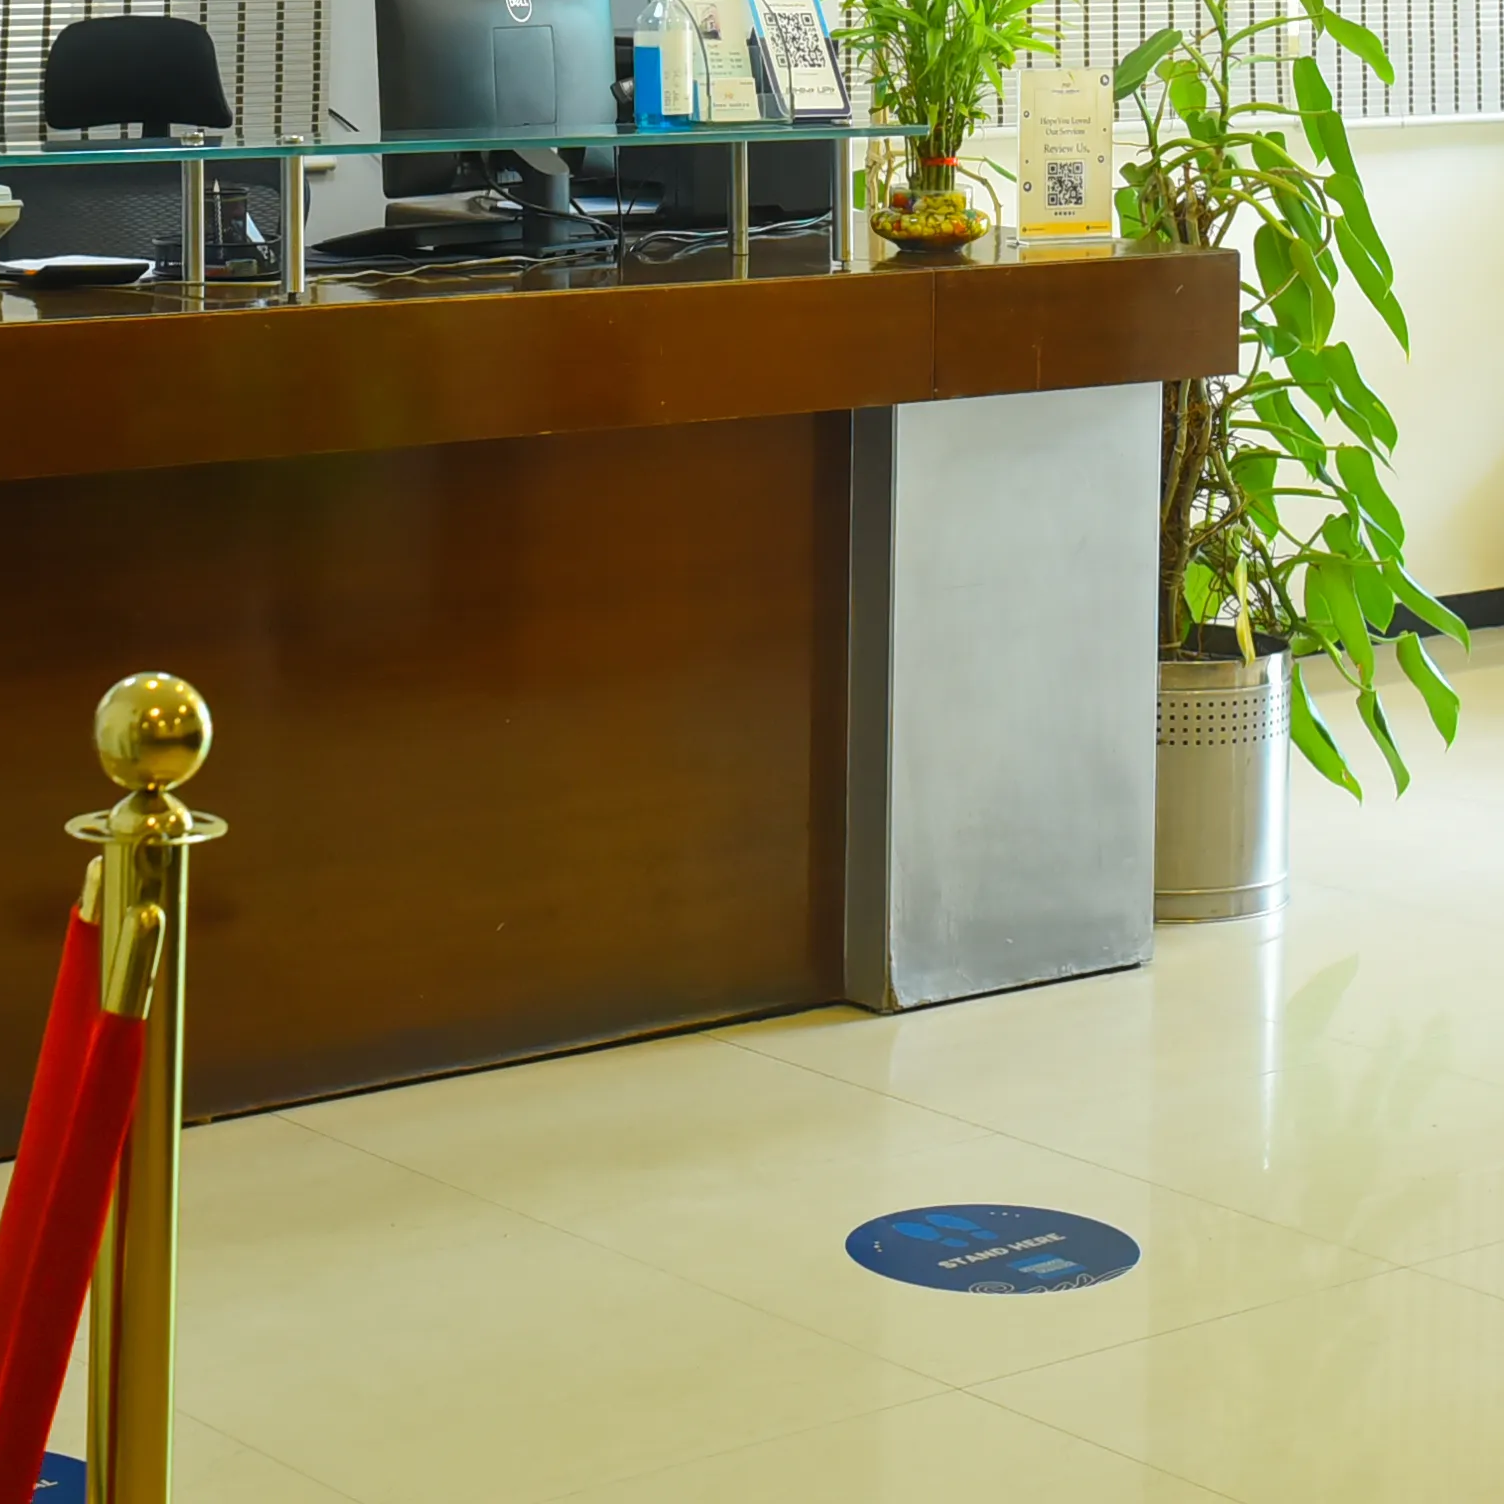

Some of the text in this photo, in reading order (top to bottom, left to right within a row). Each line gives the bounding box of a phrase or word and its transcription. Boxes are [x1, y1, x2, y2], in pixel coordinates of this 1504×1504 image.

[1071, 117, 1091, 125] Loved
[1044, 144, 1073, 153] Review
[938, 1246, 1009, 1269] STAND
[1007, 1232, 1067, 1252] HERE
